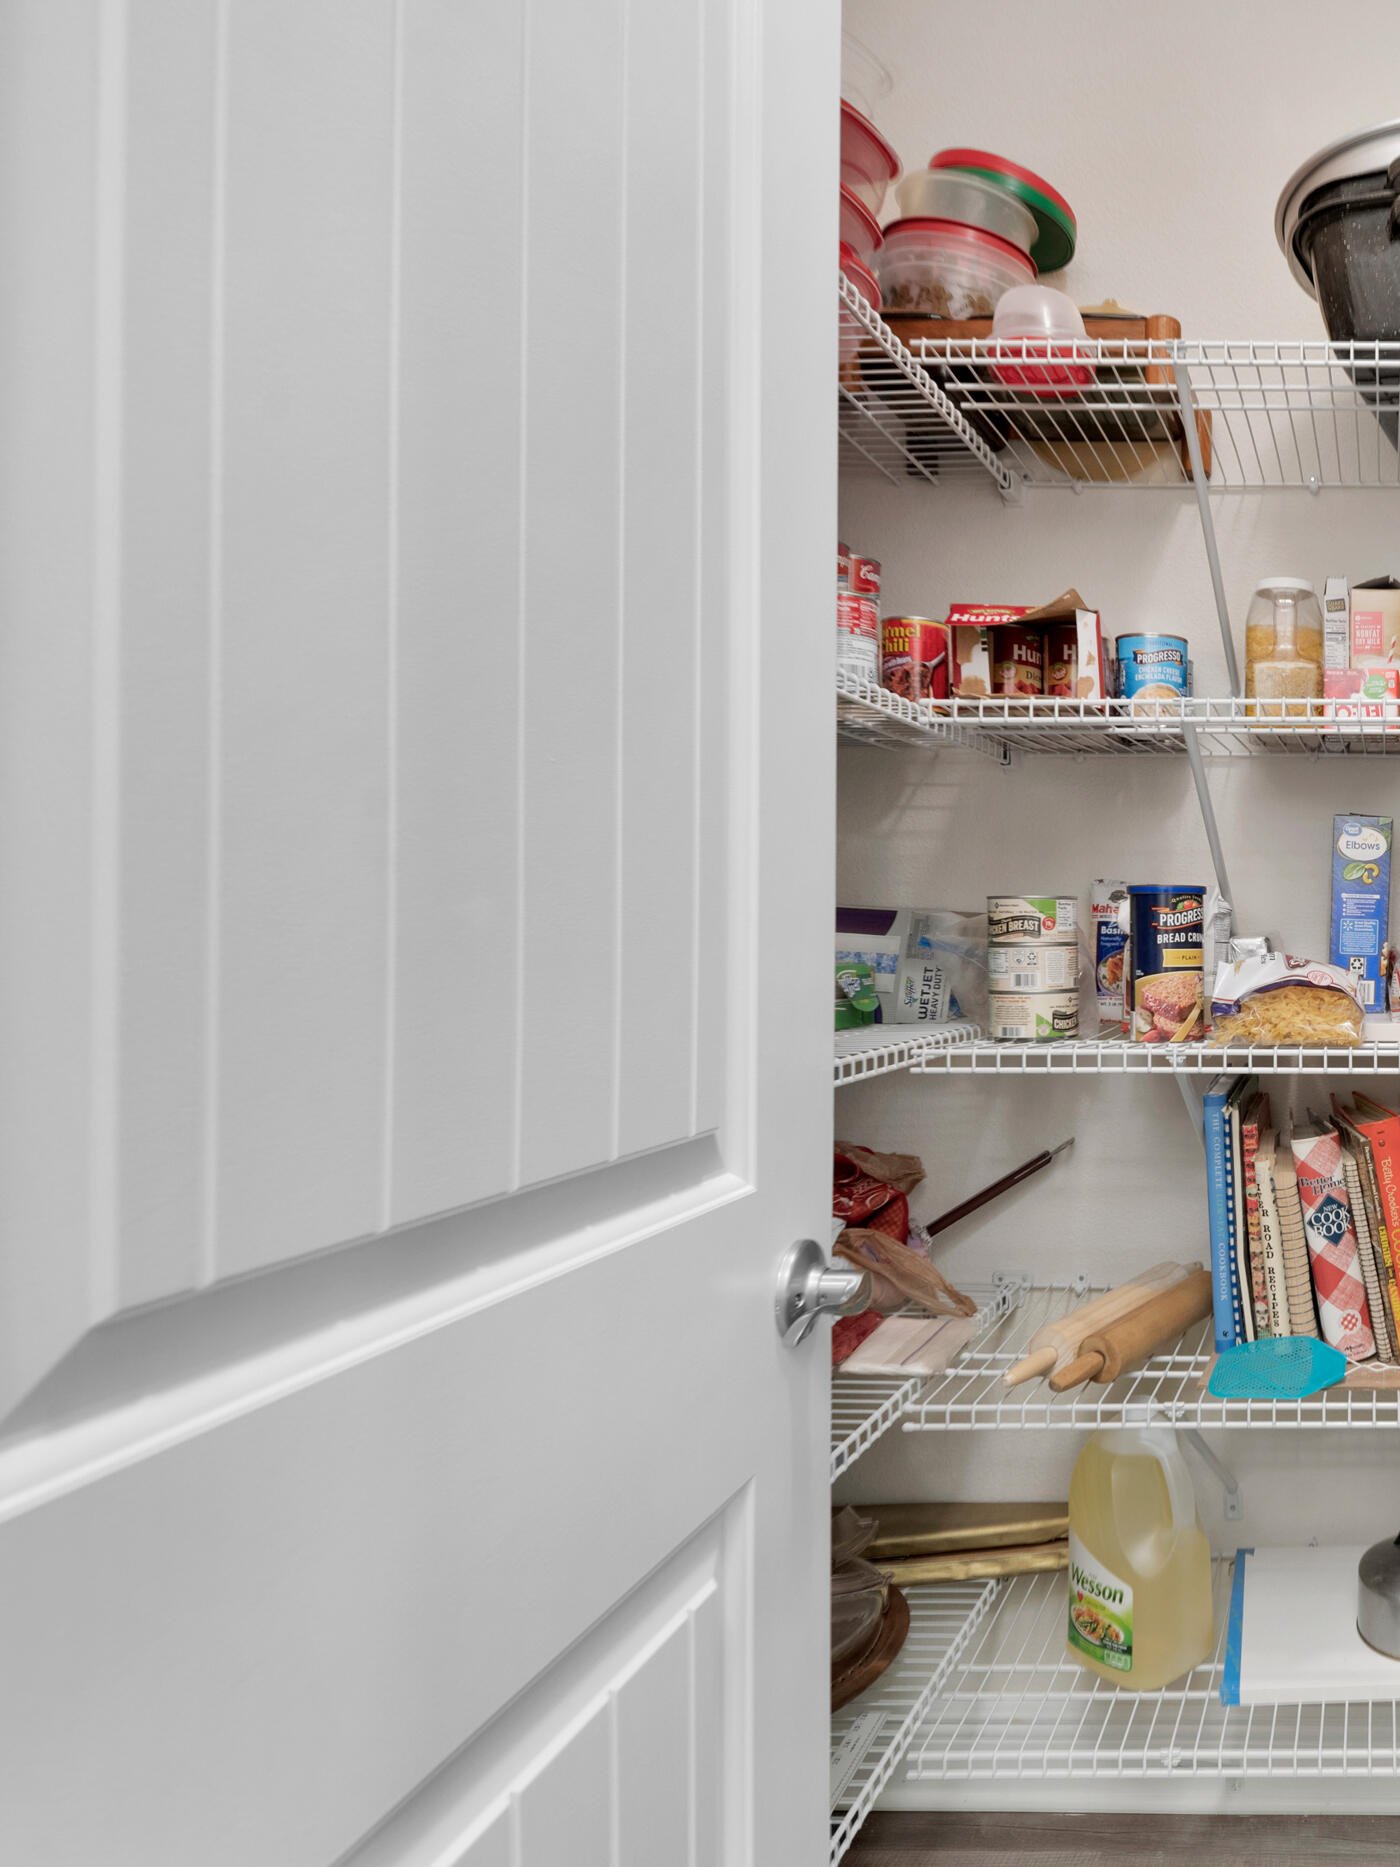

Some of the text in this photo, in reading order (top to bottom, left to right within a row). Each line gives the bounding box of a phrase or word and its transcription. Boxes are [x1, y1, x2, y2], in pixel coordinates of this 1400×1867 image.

[1136, 650, 1181, 665] PROGRESSO
[1345, 840, 1381, 851] Elbows
[1008, 919, 1040, 932] BREAST
[1157, 932, 1186, 945] BREAD
[904, 975, 918, 1008] Swiffer
[918, 966, 934, 1020] WETJET
[929, 967, 943, 1021] HEAVY DUTY
[1212, 1111, 1221, 1131] THE
[1213, 1136, 1223, 1190] COMPLETE
[1381, 1155, 1394, 1185] Betty
[1300, 1175, 1334, 1187] Better
[1311, 1206, 1351, 1226] COOK
[1323, 1203, 1339, 1213] NEW
[1385, 1184, 1400, 1227] Crocker's
[1263, 1224, 1274, 1259] ROAD
[1313, 1218, 1353, 1237] BOOK
[1217, 1242, 1228, 1302] COOKBOOK
[1267, 1266, 1280, 1328] RECIPES
[1071, 1560, 1124, 1605] Wesson
